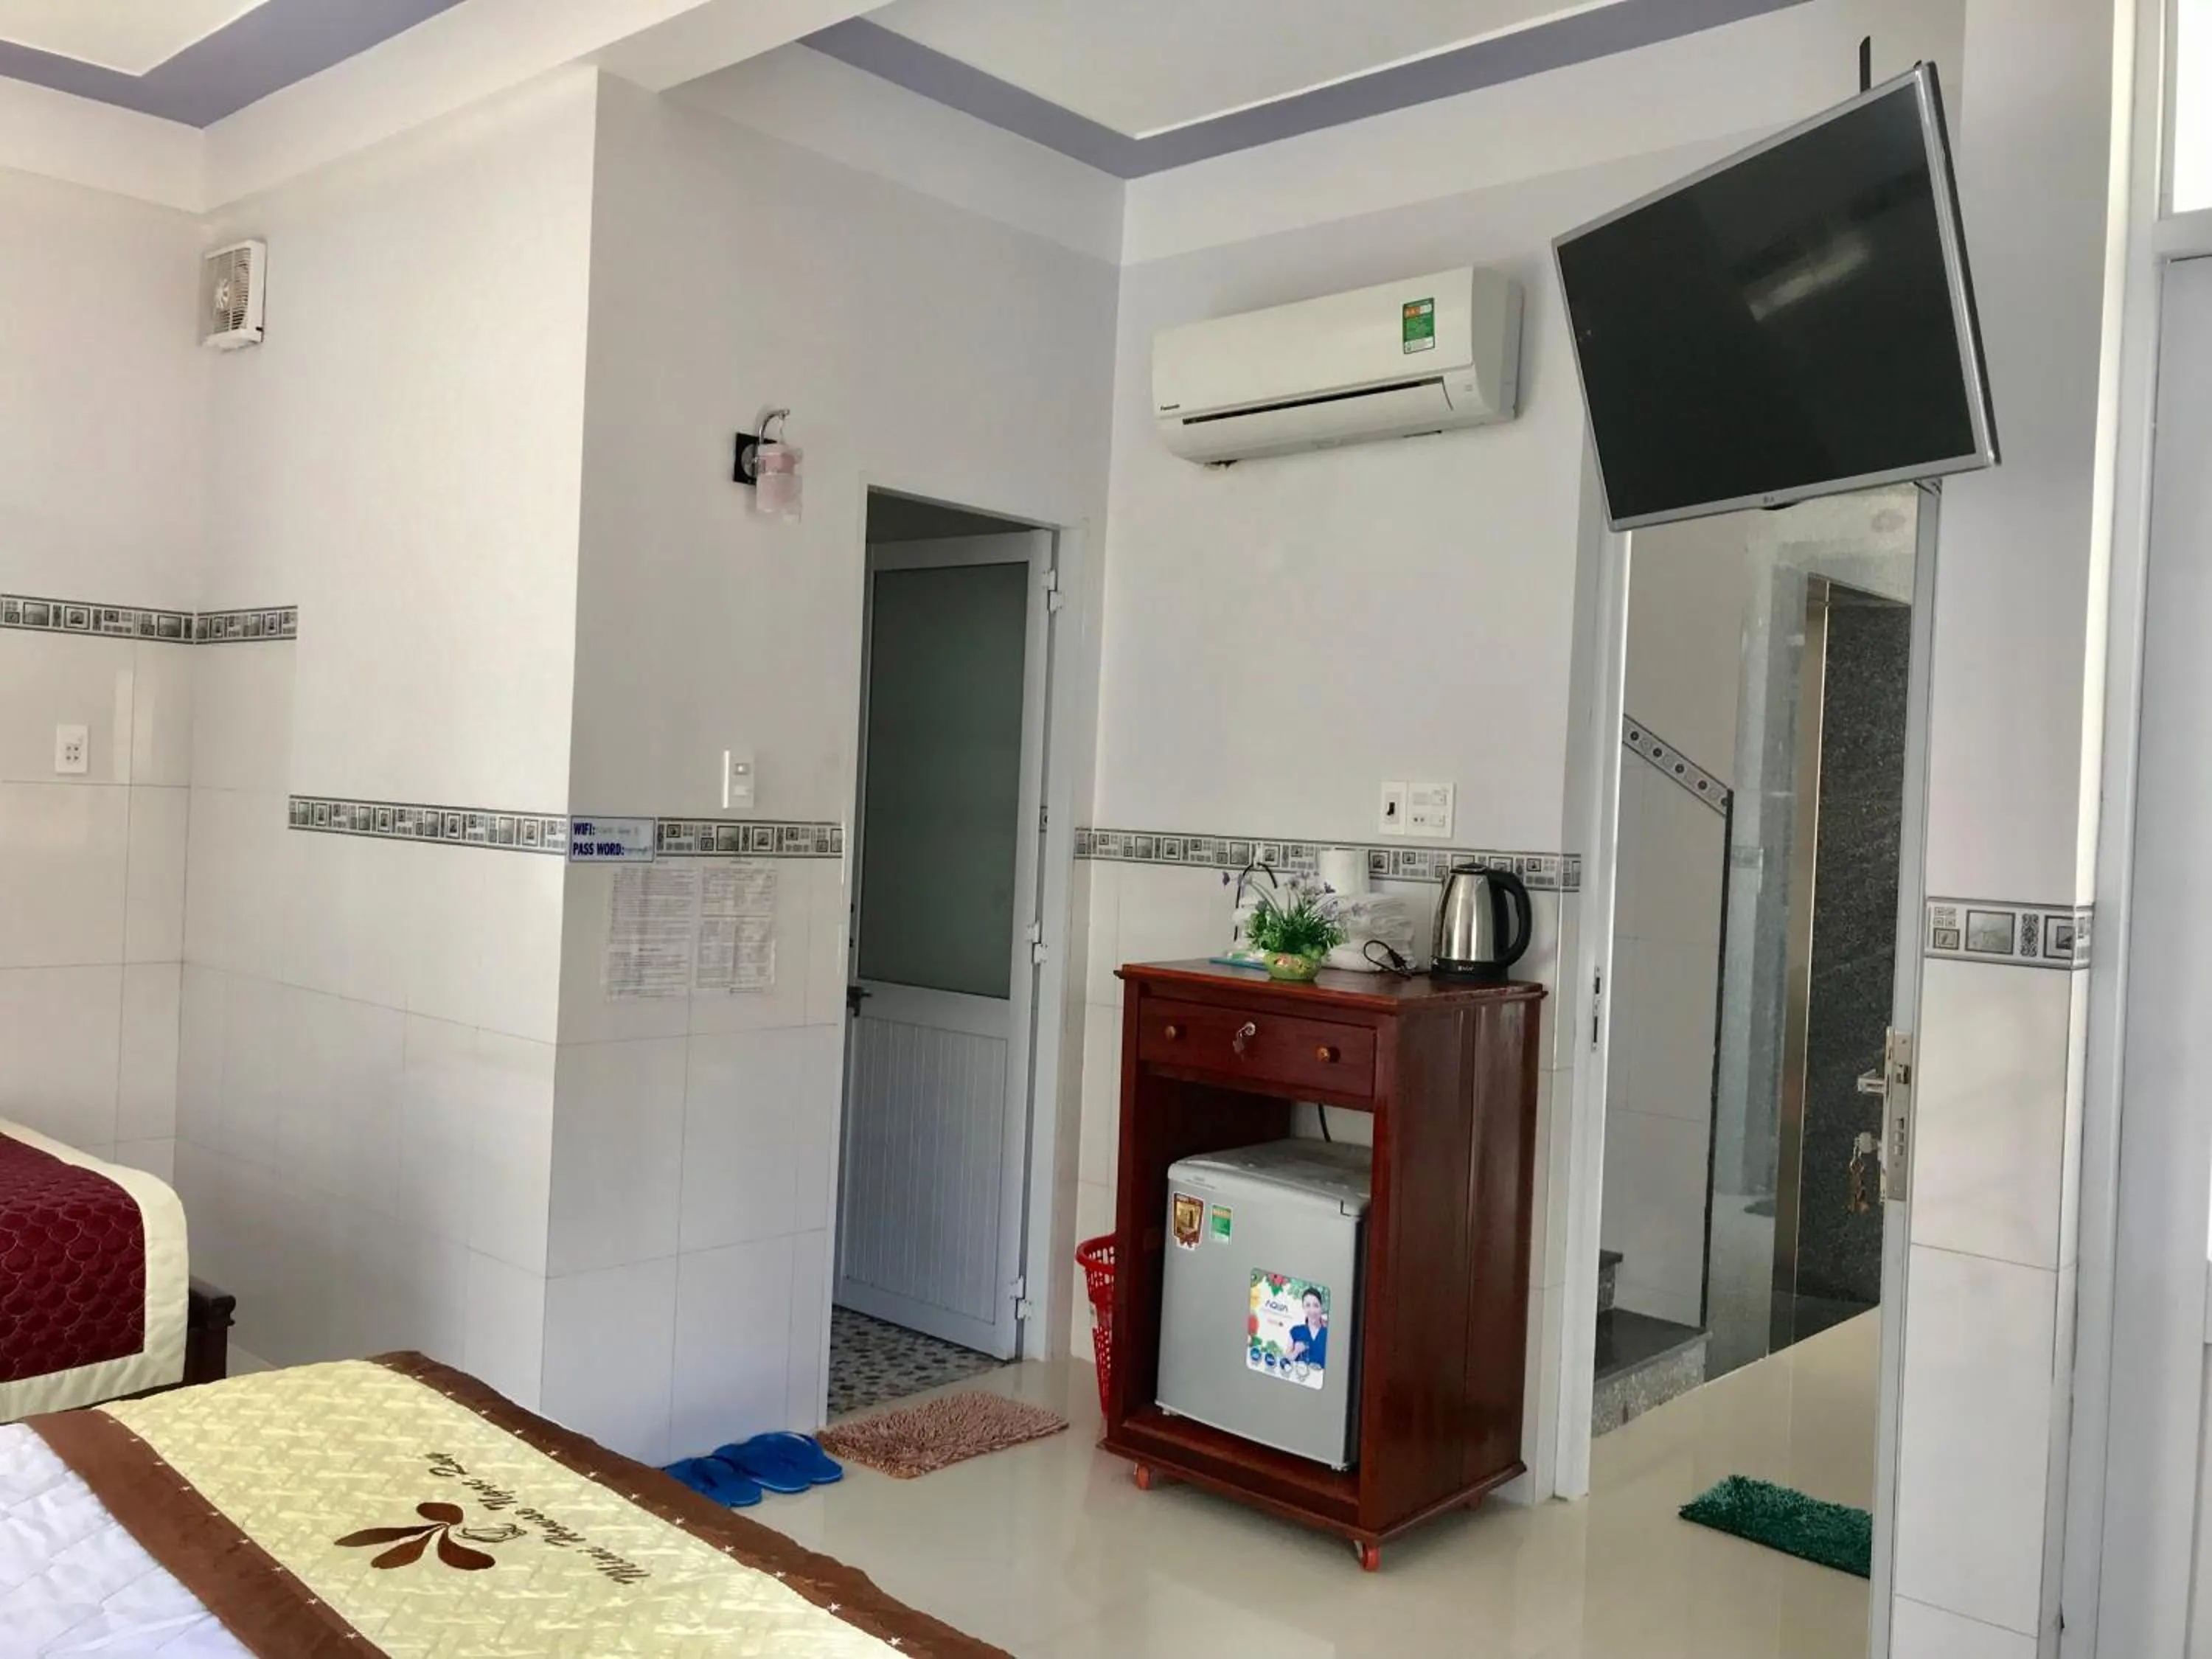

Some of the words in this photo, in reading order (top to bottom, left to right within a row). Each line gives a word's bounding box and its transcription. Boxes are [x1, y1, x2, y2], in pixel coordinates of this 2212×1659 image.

[574, 822, 595, 835] WIFI:
[573, 842, 594, 855] PASS
[597, 842, 625, 856] WORD:
